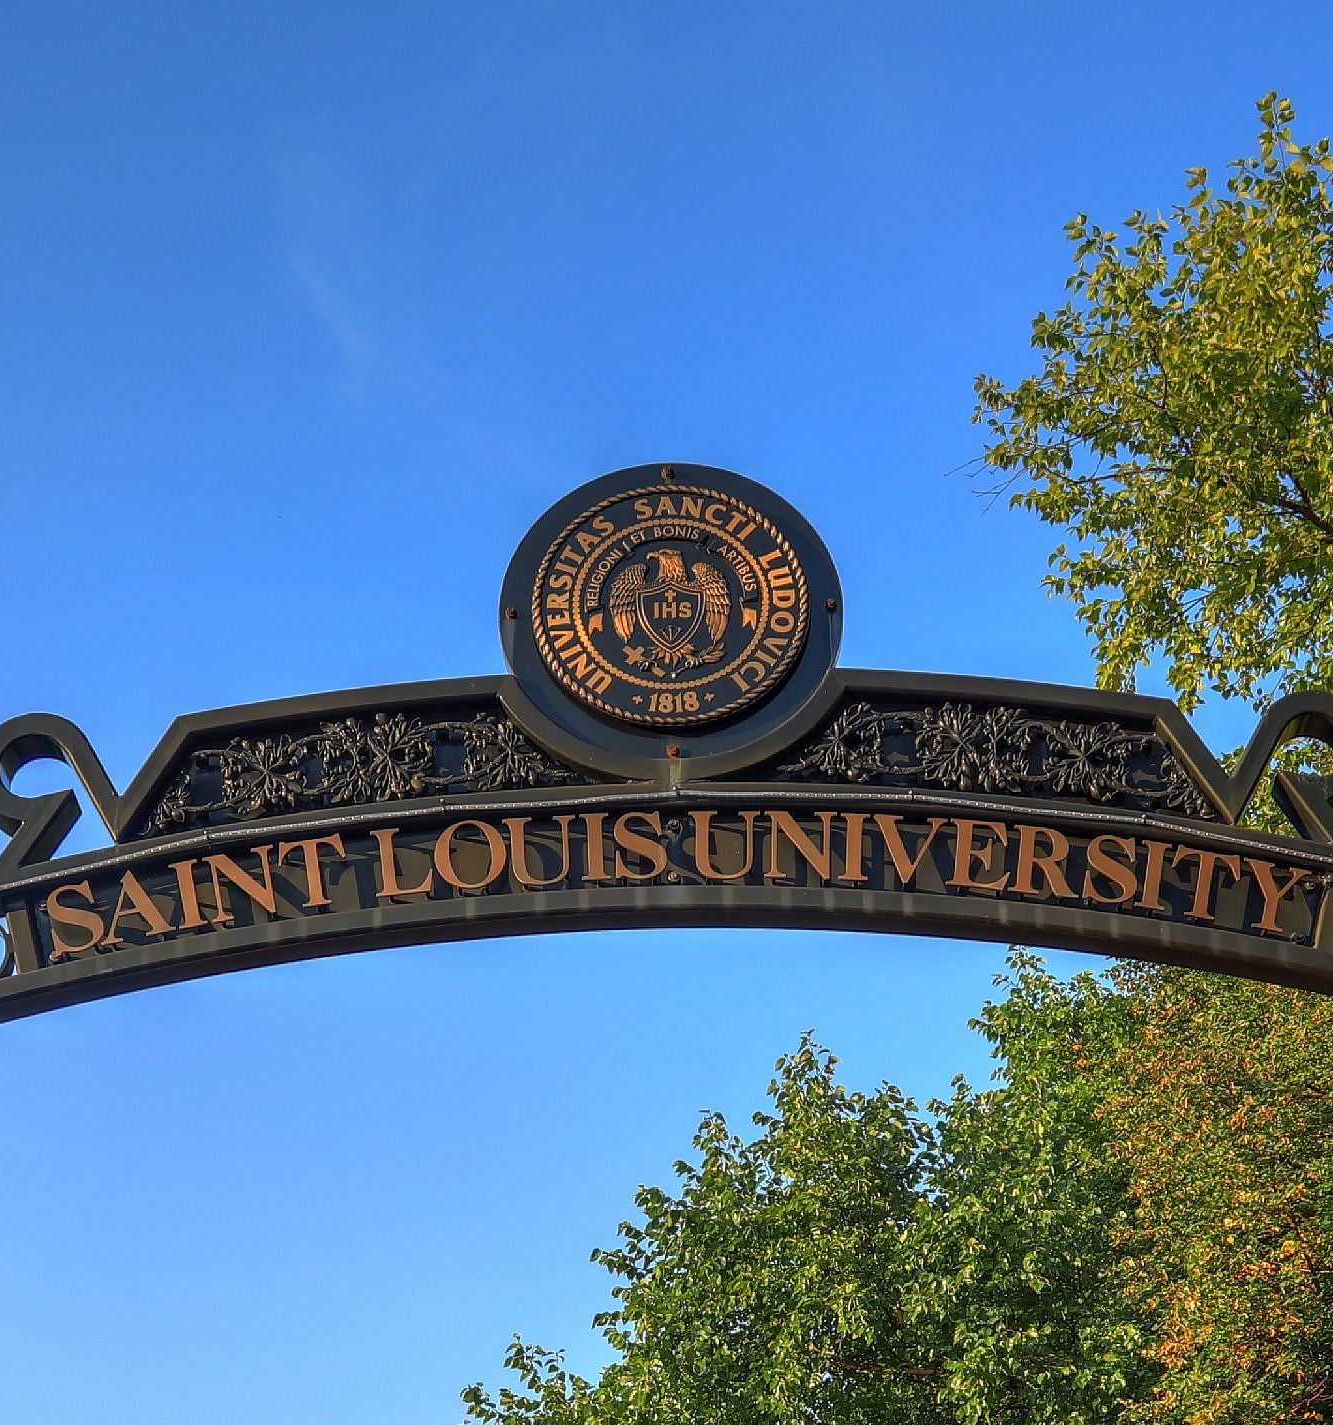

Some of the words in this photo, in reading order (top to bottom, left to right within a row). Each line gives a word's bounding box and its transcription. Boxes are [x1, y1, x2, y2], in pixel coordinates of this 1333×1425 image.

[630, 529, 646, 544] ET
[653, 525, 701, 540] BONIS
[717, 545, 757, 592] ARTIBUS
[546, 514, 616, 695] UNIVERSITAS
[633, 496, 758, 540] SANCTI
[730, 549, 796, 693] LUDOVICI
[653, 601, 693, 619] IHS
[648, 691, 701, 714] 1818
[44, 832, 348, 963] SAINT
[370, 810, 669, 898] LOUIS
[687, 810, 1311, 934] UNIVERSITY
